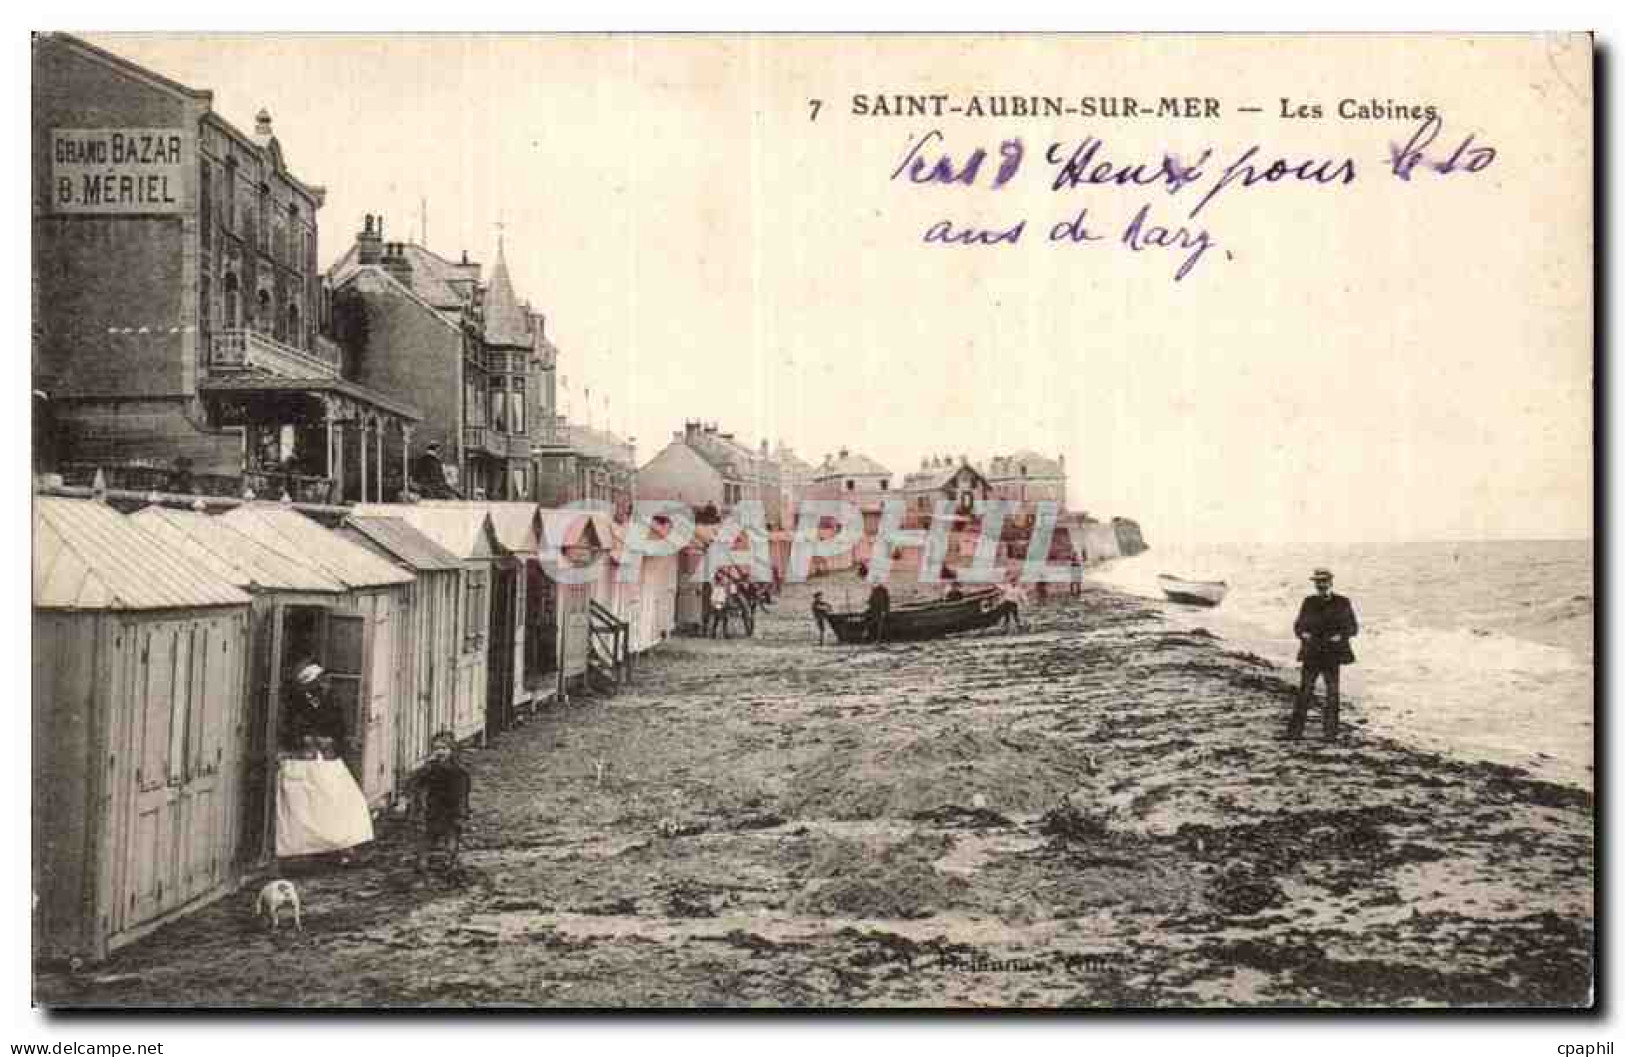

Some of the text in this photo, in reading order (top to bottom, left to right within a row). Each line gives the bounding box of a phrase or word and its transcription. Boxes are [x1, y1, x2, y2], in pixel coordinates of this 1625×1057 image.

[112, 133, 181, 164] BAZAR
[83, 167, 175, 205] MÉRIEL
[1189, 145, 1356, 218] pour
[1049, 207, 1103, 242] de
